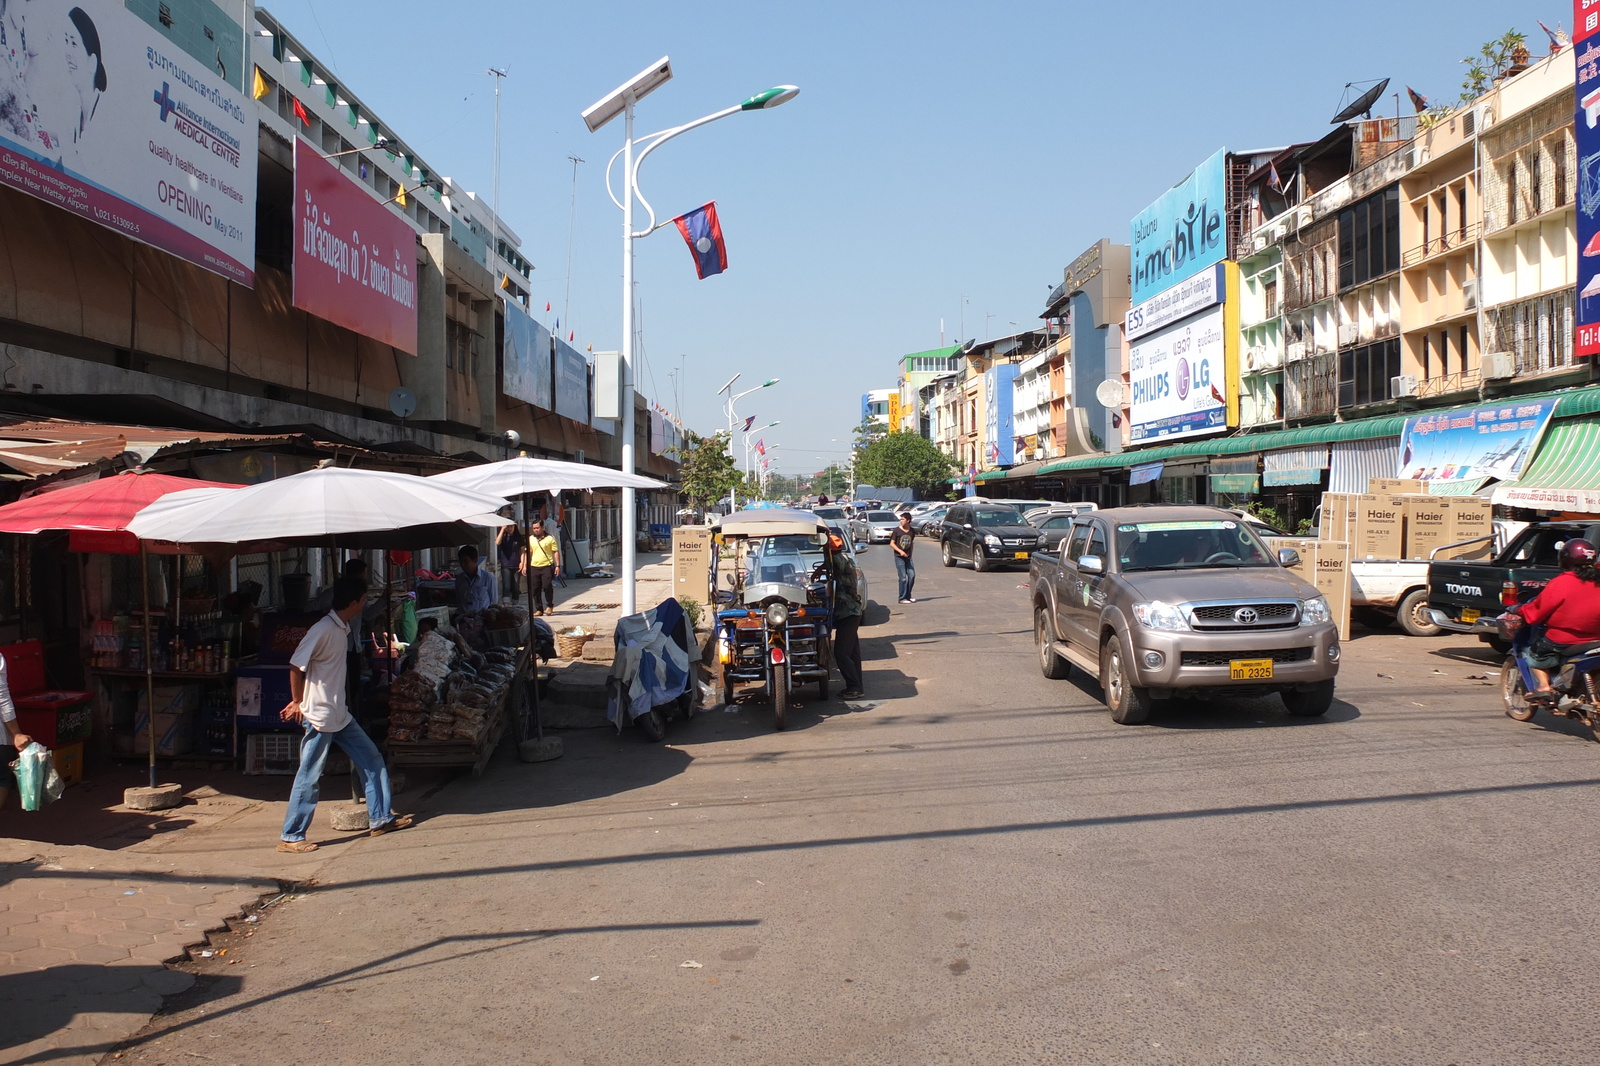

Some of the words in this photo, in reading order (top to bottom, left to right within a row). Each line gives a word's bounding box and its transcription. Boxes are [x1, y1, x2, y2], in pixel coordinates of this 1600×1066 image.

[176, 100, 203, 125] Alliance
[203, 116, 241, 150] International
[174, 118, 210, 150] MEDICAL
[211, 141, 240, 168] CENTRE
[148, 140, 174, 166] Quality
[175, 154, 209, 184] healthcare
[210, 174, 217, 188] in
[217, 180, 244, 204] Vientiane
[0, 167, 23, 184] mplex
[24, 176, 41, 191] Near
[42, 184, 66, 203] Wattay
[67, 195, 89, 213] Airport
[99, 209, 111, 221] 021
[112, 214, 140, 233] 513092-5
[157, 179, 213, 226] OPENING
[214, 216, 228, 237] May
[228, 224, 243, 243] 2011
[1134, 197, 1220, 293] i-mobile
[361, 244, 368, 286] 2
[1128, 307, 1144, 332] ESS
[1133, 371, 1170, 406] PHILIPS
[1192, 358, 1211, 390] LG
[1367, 509, 1396, 519] Haier
[1416, 511, 1443, 521] Haier
[1457, 511, 1485, 521] Haier
[679, 541, 702, 549] Haier
[1445, 583, 1483, 597] TOYOTA
[1248, 667, 1271, 678] 2325
